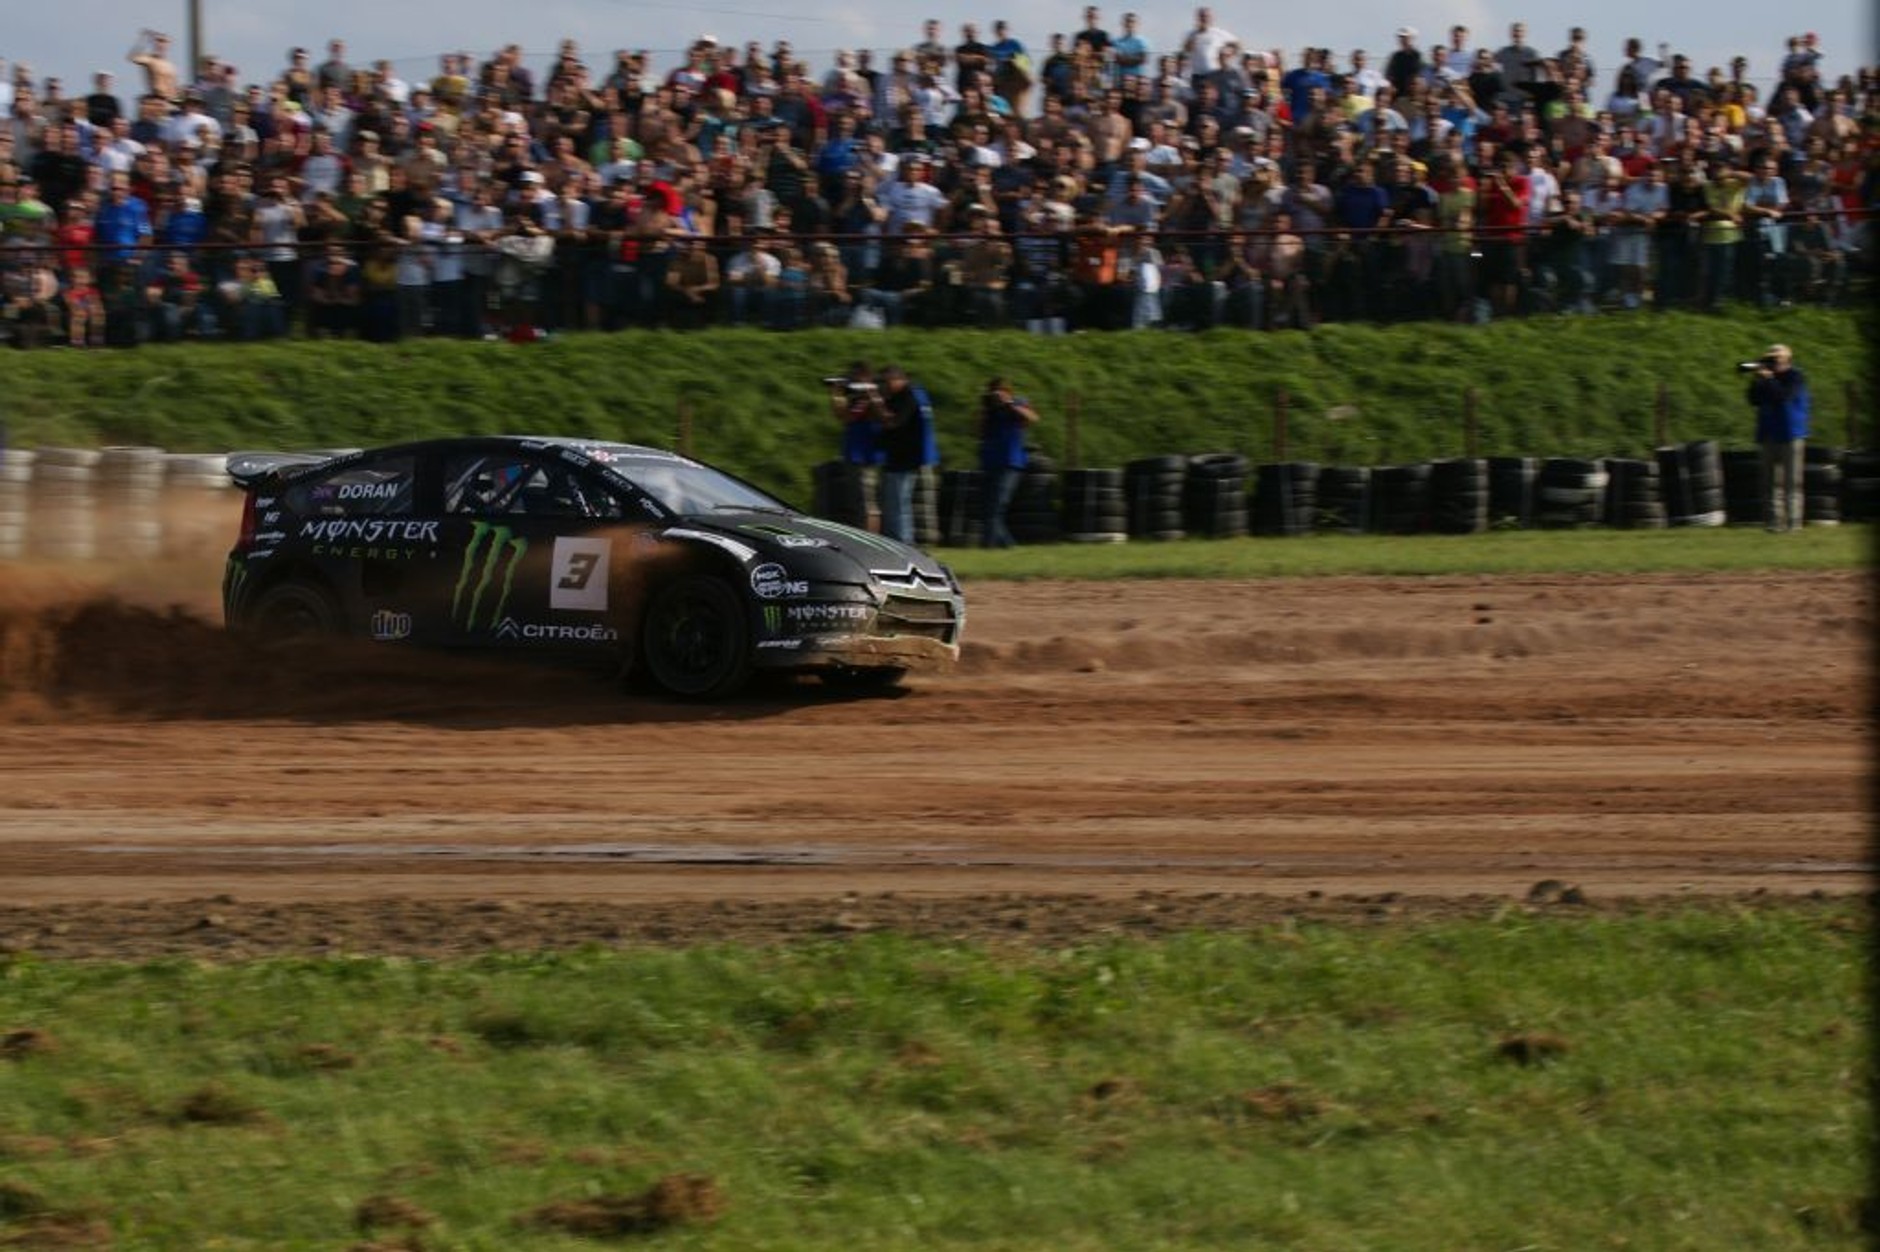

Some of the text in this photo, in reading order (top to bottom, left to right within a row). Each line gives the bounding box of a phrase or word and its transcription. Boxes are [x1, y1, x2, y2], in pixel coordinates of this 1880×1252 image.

[338, 484, 398, 499] DORAN
[312, 545, 415, 560] ENERGY
[558, 553, 600, 590] 3
